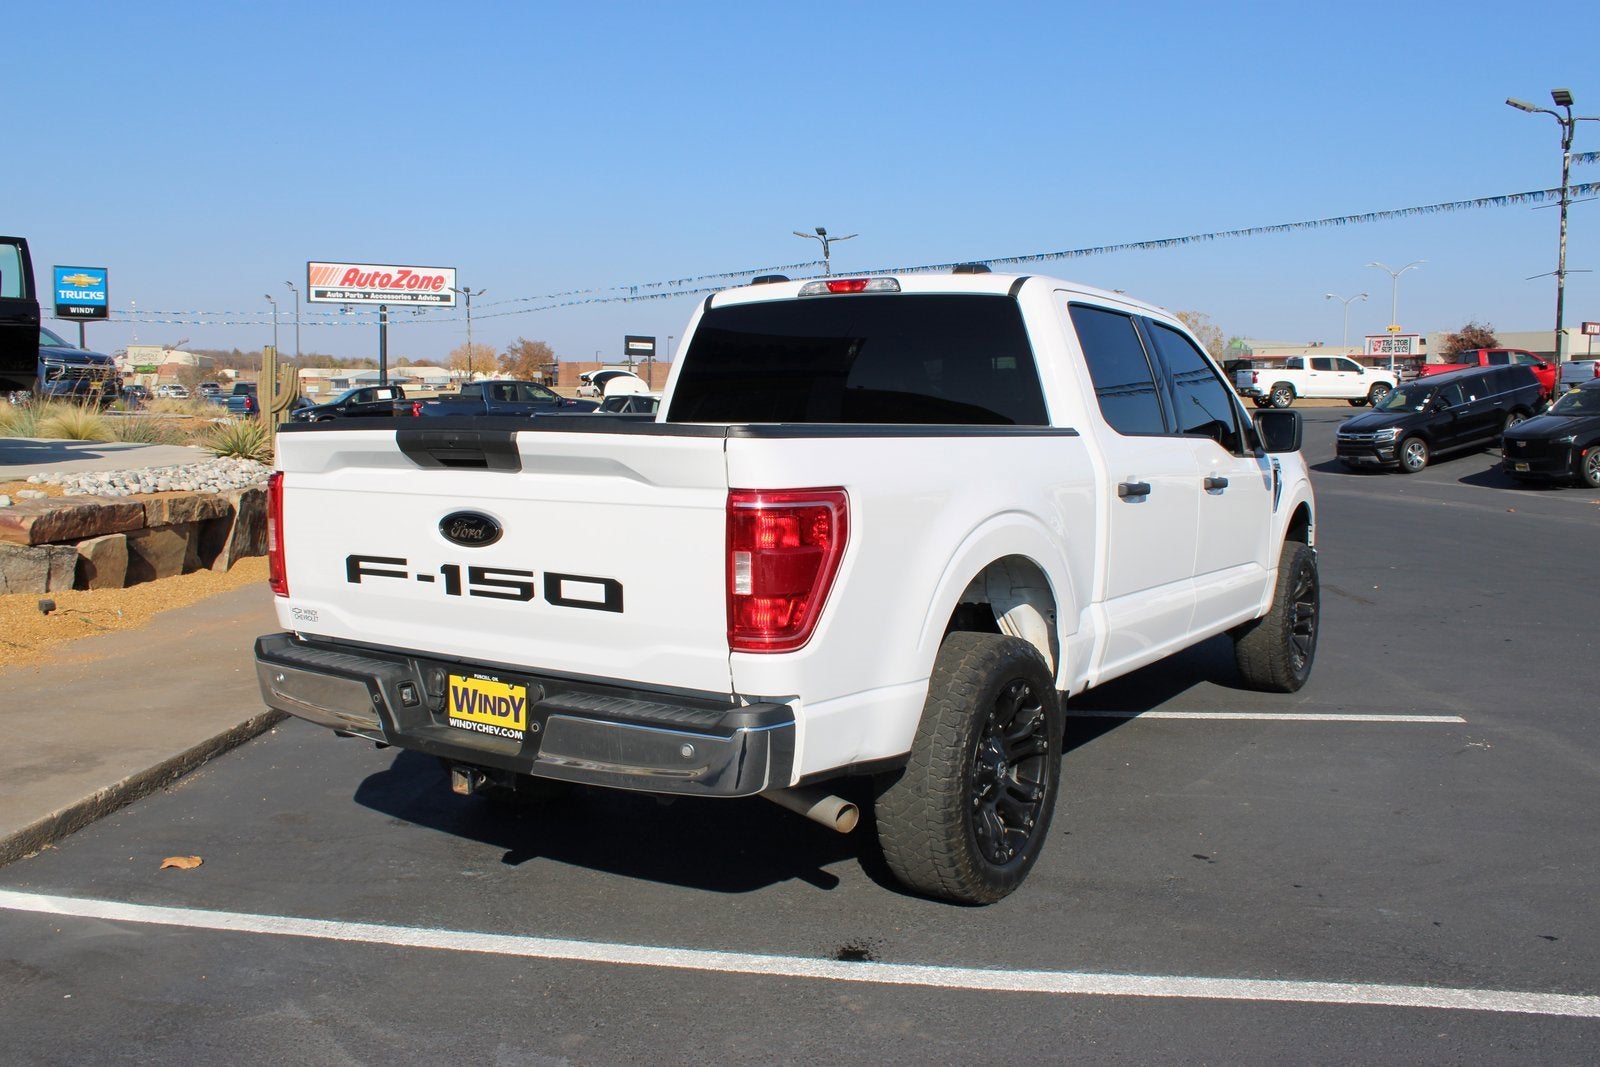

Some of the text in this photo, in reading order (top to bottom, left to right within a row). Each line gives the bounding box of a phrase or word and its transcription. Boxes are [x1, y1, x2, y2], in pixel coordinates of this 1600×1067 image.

[339, 268, 446, 291] AutoZone
[59, 290, 105, 300] TRUCKS
[345, 291, 364, 299] Parts
[370, 292, 412, 301] Accessories
[418, 294, 441, 302] Advice
[1586, 325, 1600, 333] ATM
[451, 518, 486, 539] Ford
[346, 554, 624, 613] F-150
[452, 685, 525, 723] WINDY
[449, 717, 523, 740] WINDYCHEV.COM
